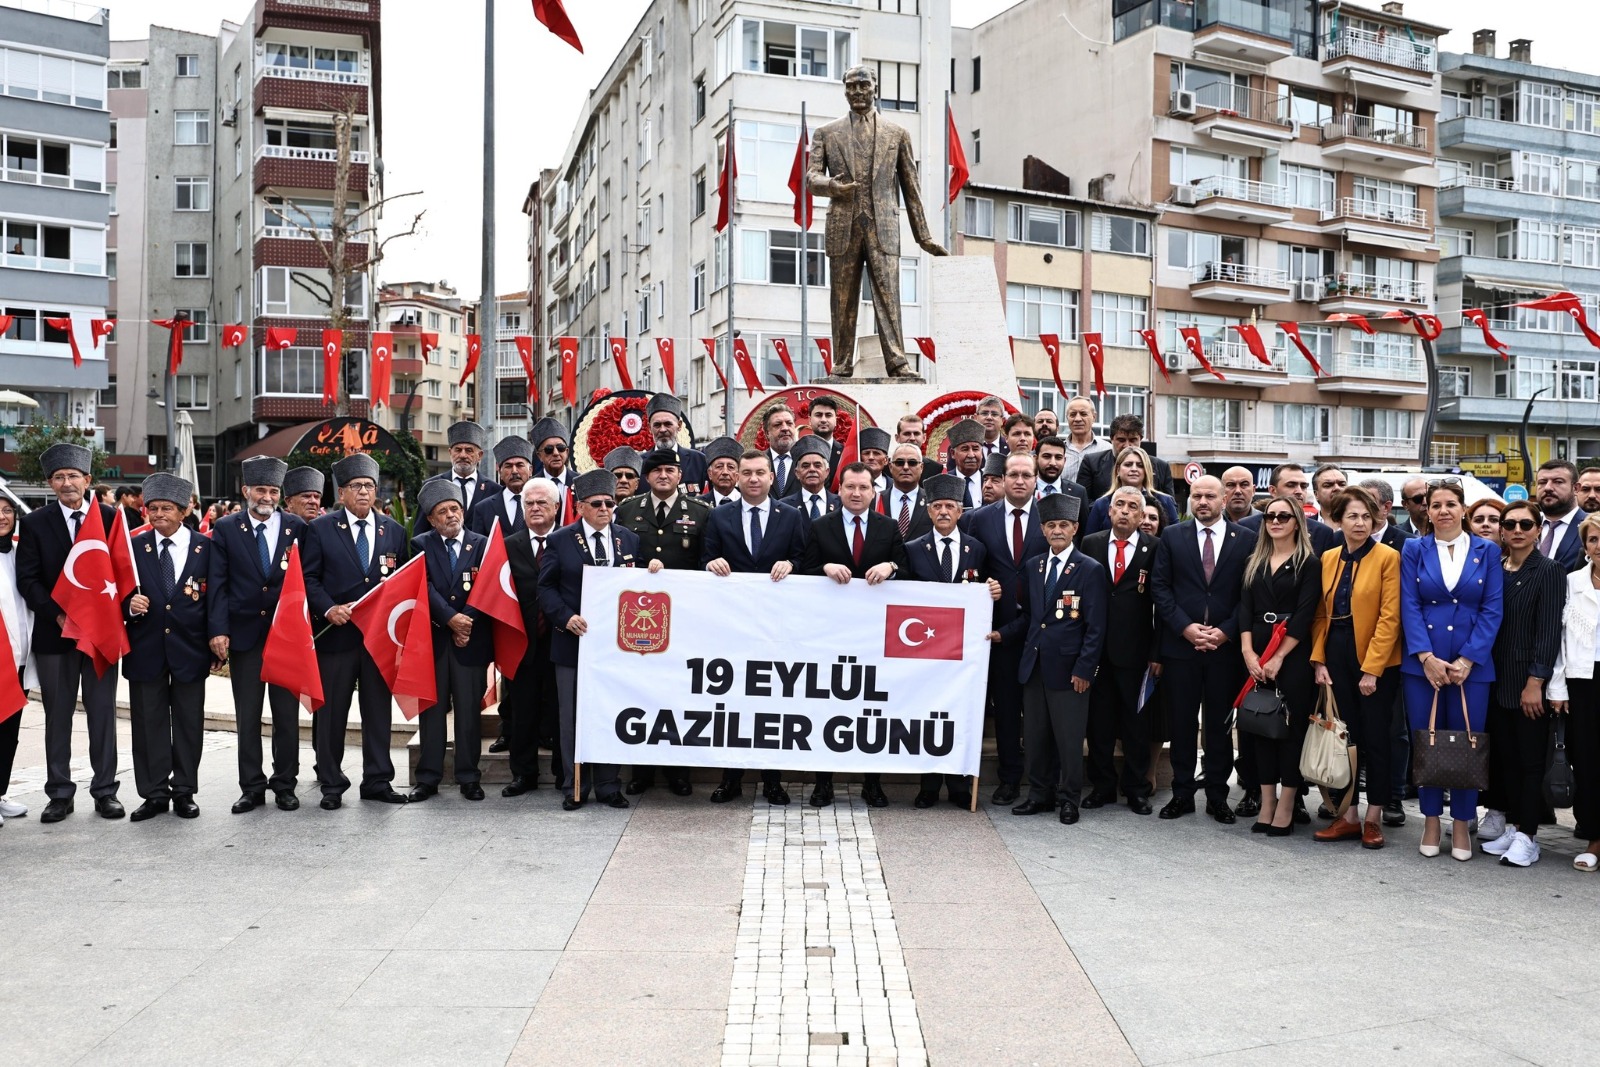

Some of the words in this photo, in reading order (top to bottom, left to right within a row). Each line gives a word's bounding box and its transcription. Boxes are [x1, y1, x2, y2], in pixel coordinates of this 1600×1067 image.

[686, 657, 733, 696] 19
[745, 655, 889, 702] EYLÜL
[614, 702, 813, 751] GAZİLER
[823, 708, 955, 757] GÜNÜ
